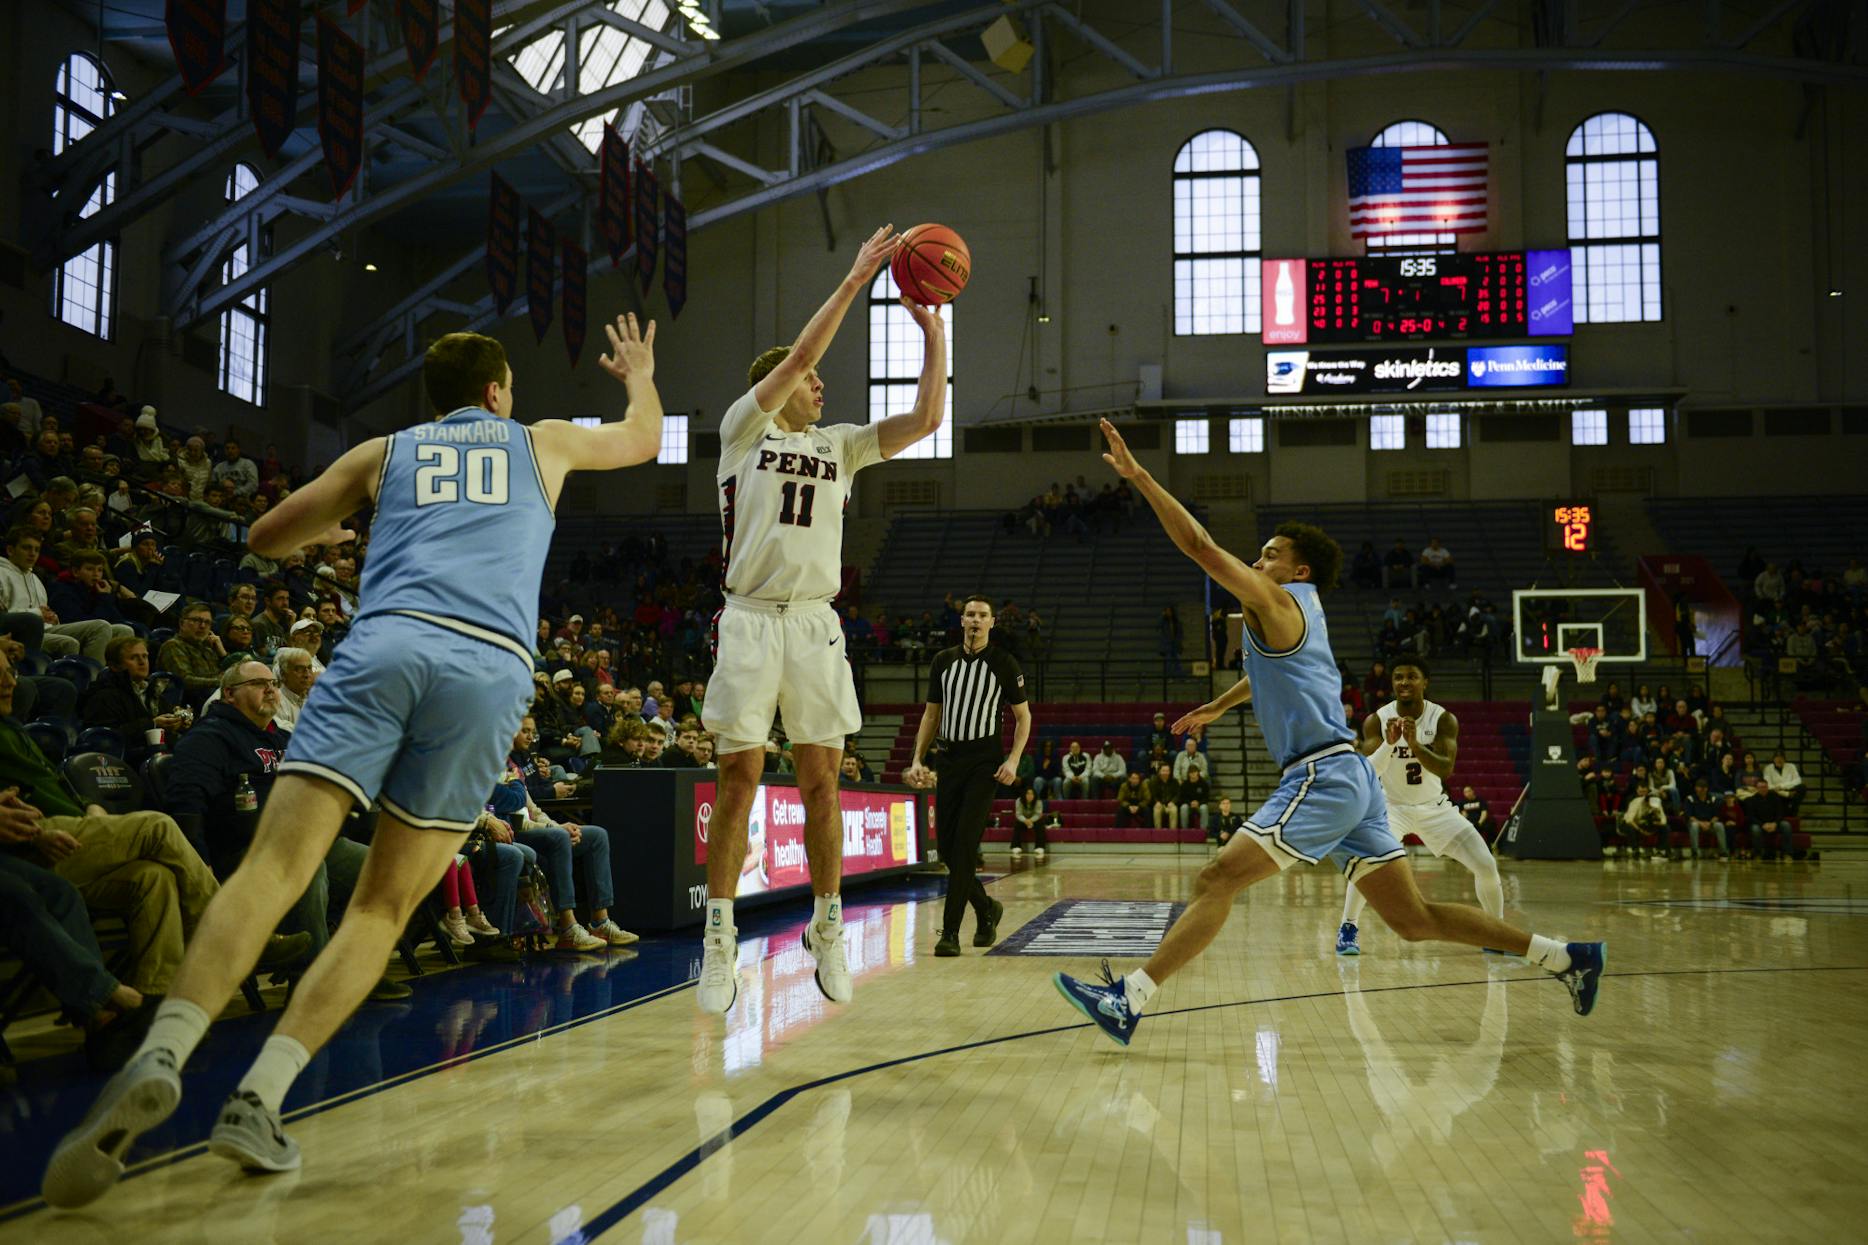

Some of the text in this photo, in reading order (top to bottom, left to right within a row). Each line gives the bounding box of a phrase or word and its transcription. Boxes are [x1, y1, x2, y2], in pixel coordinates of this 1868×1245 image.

[1400, 258, 1437, 277] 15:35
[1269, 329, 1302, 341] enjoy
[1487, 358, 1566, 373] Penn Medicine
[414, 420, 510, 443] STANKARD
[415, 443, 510, 508] 20
[756, 449, 837, 482] PENN
[779, 481, 815, 528] 11
[1555, 507, 1590, 523] 15:35
[1564, 523, 1587, 550] 12
[1406, 762, 1422, 784] 2
[773, 799, 788, 826] Get
[774, 838, 804, 873] healthy
[689, 884, 708, 910] TOY
